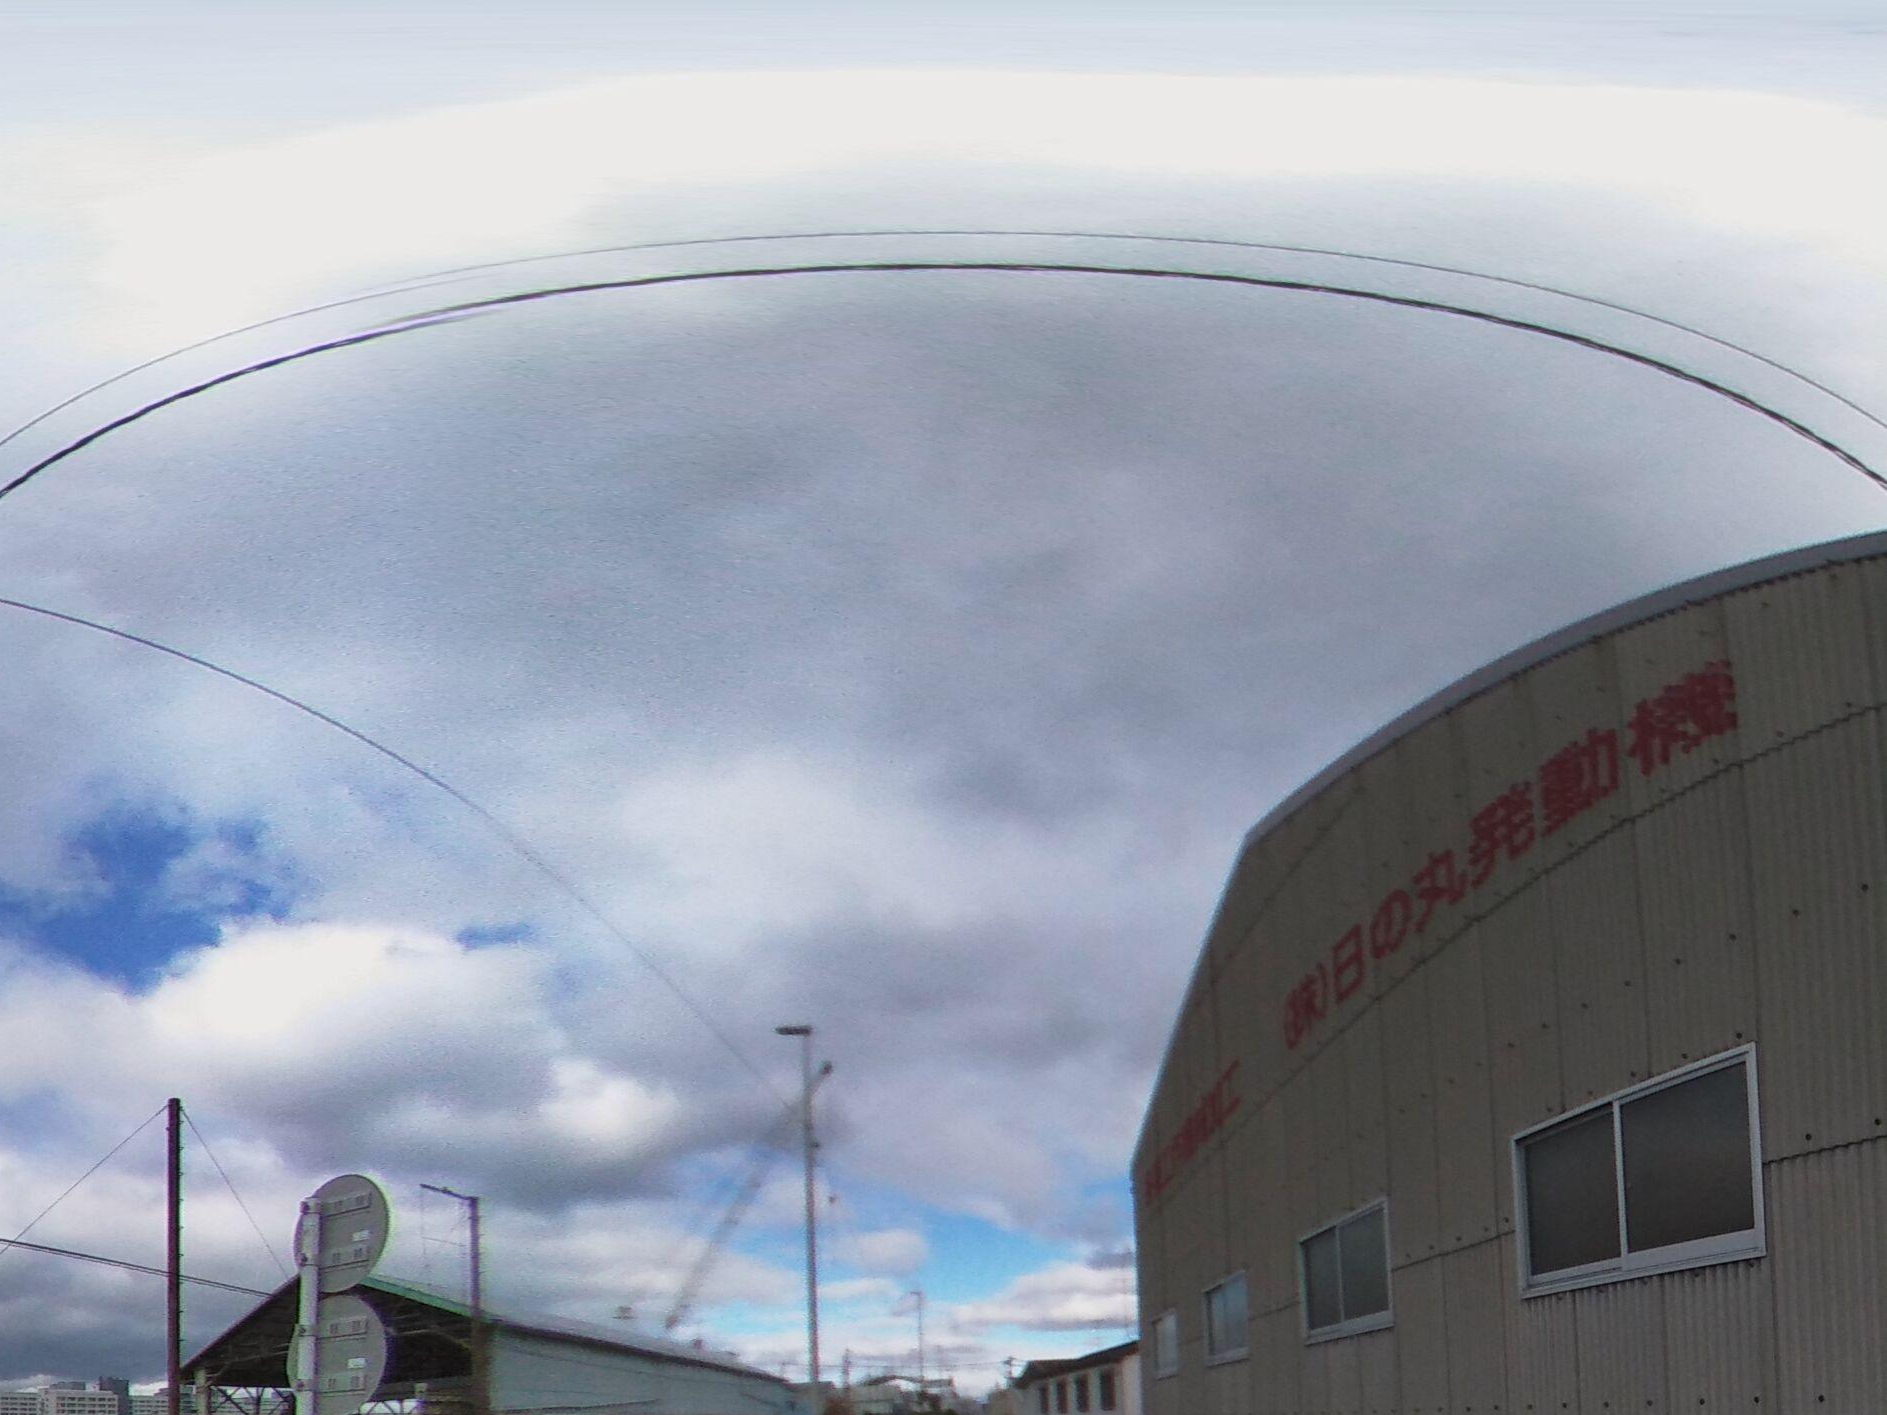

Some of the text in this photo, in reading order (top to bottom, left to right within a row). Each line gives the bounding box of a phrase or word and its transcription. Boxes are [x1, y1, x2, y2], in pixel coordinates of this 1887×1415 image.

[1283, 658, 1739, 1050] (株)日の丸発動機
